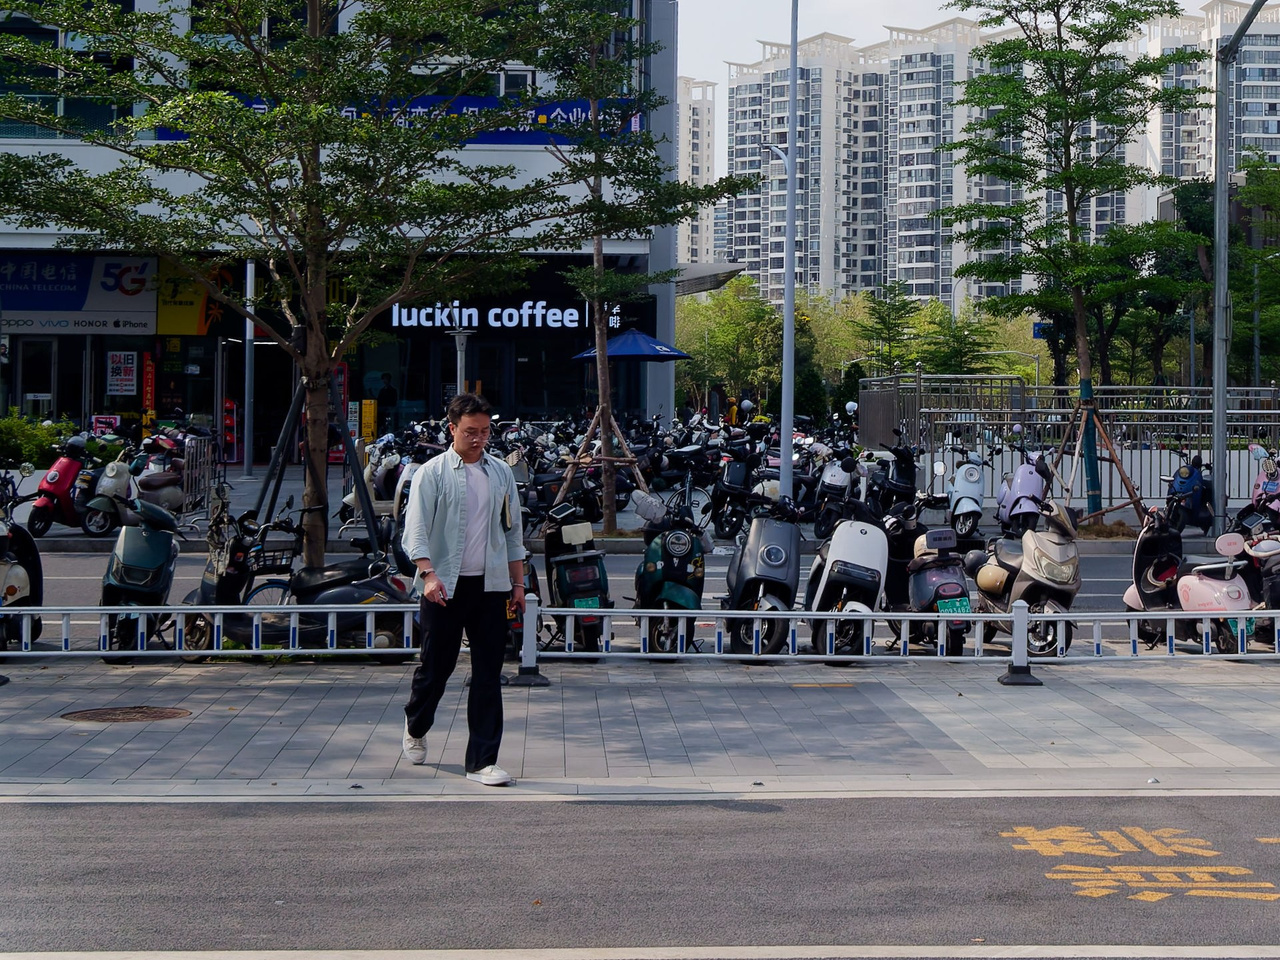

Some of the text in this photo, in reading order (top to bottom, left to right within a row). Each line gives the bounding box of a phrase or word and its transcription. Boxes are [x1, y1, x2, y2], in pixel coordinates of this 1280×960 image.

[0, 261, 78, 282] 中国电信
[101, 263, 148, 295] 5G
[0, 283, 77, 292] CHINA TELECOM
[391, 300, 579, 328] luckin coffee
[74, 320, 108, 328] HONOR
[122, 320, 148, 329] iPhone
[110, 353, 134, 365] 以旧
[110, 365, 134, 377] 换新
